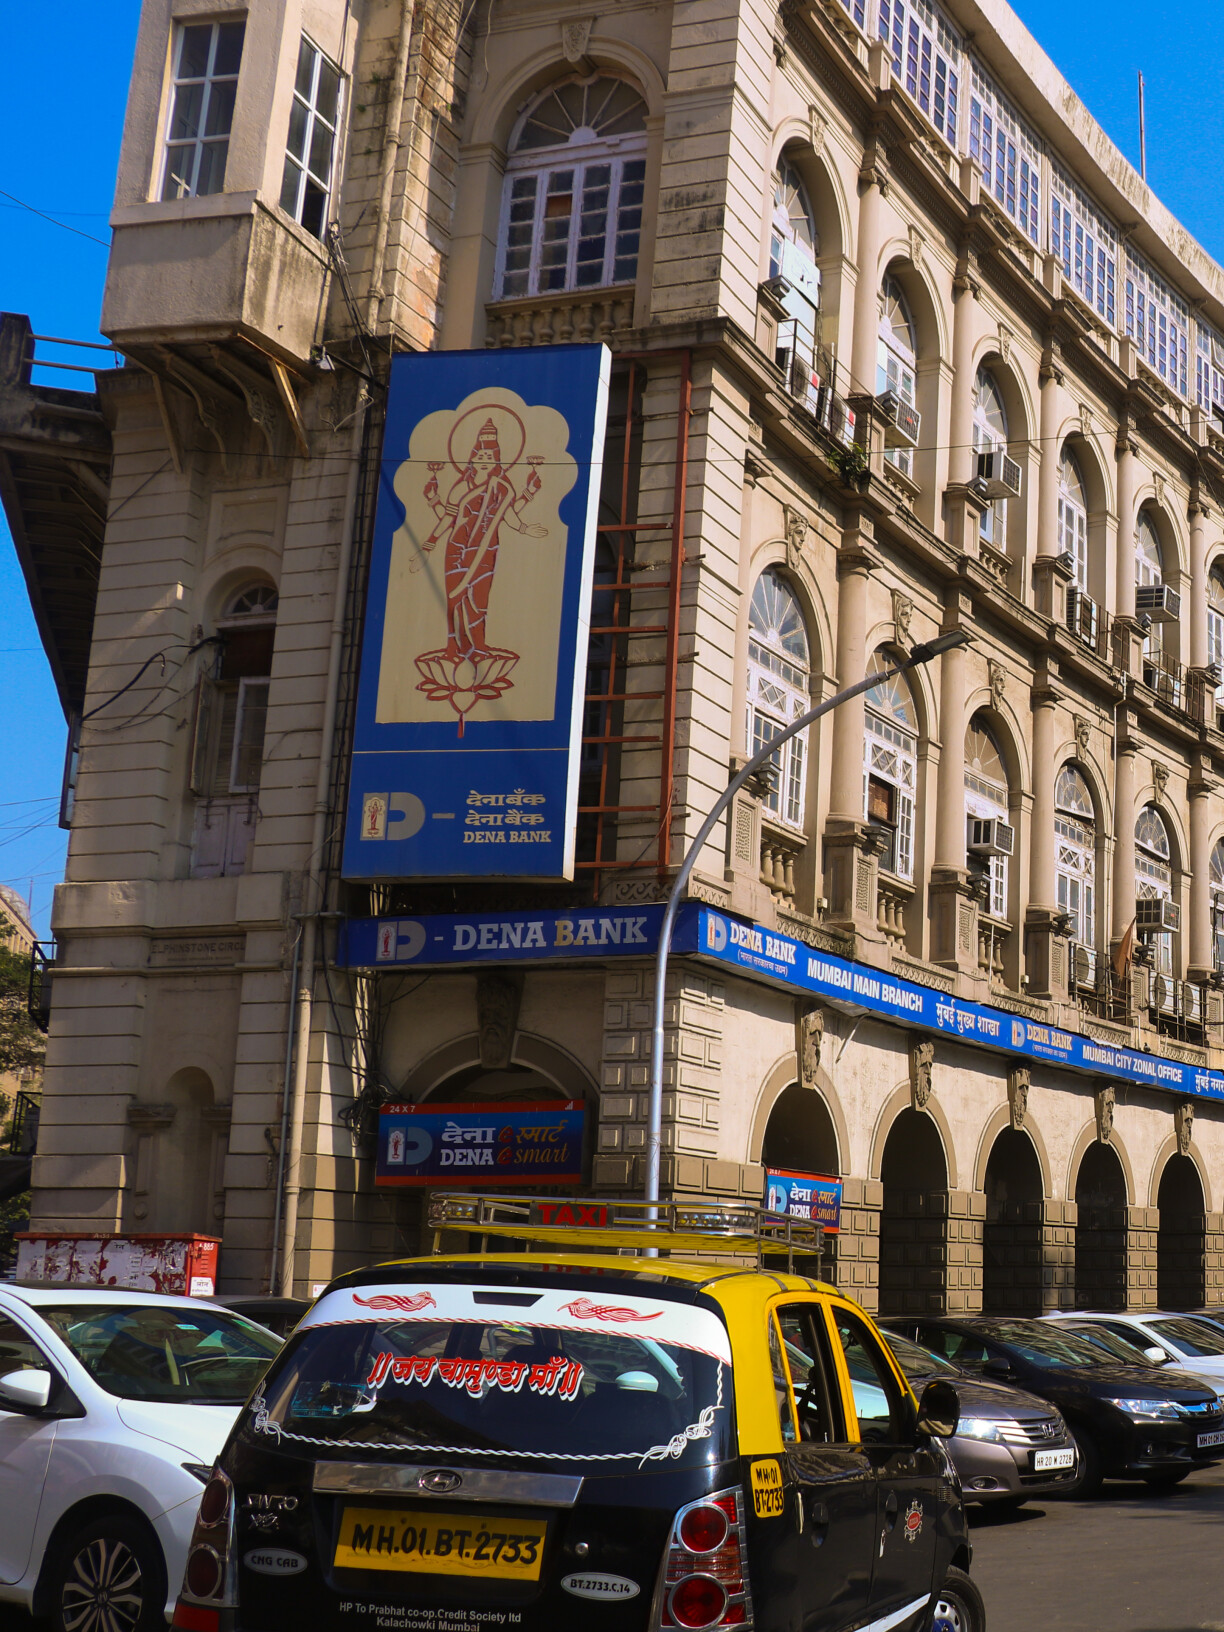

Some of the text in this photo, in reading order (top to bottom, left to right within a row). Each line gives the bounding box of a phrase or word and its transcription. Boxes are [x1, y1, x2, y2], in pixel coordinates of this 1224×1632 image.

[466, 790, 504, 807] देना
[464, 809, 545, 826] देना बैंक
[463, 831, 552, 843] DENA BANK
[452, 922, 547, 951] DENA
[554, 916, 648, 947] BANK
[730, 922, 797, 965] DENA BANK
[151, 942, 245, 953] ELPHINSTONE CIRCL
[807, 957, 923, 1013] MUMBAI MAIN BRANCH
[935, 996, 1000, 1037] मुंबई मुख्य शाखा
[1027, 1024, 1073, 1051] DENA BANK
[1083, 1045, 1182, 1082] MUMBAI CITY ZONAL OFFICE
[1195, 1069, 1210, 1092] मुंबई
[1210, 1078, 1224, 1093] नगर
[389, 1105, 416, 1113] 24 X 7
[440, 1121, 496, 1145] देना
[439, 1148, 494, 1166] DENA
[513, 1143, 569, 1164] smart
[790, 1182, 811, 1201] देना
[538, 1204, 608, 1226] TAXI
[790, 1204, 810, 1219] DENA
[392, 1355, 438, 1387] जय
[438, 1357, 529, 1398] चामुण्डा
[528, 1356, 567, 1395] माँ
[251, 1555, 299, 1568] CNG CAB
[570, 1579, 630, 1594] BT.2733.C.14
[340, 1602, 352, 1612] HP
[355, 1603, 366, 1613] To
[369, 1604, 405, 1616] Prabhat
[469, 1610, 506, 1624] Society
[377, 1617, 480, 1632] Kalachowki Mumbai
